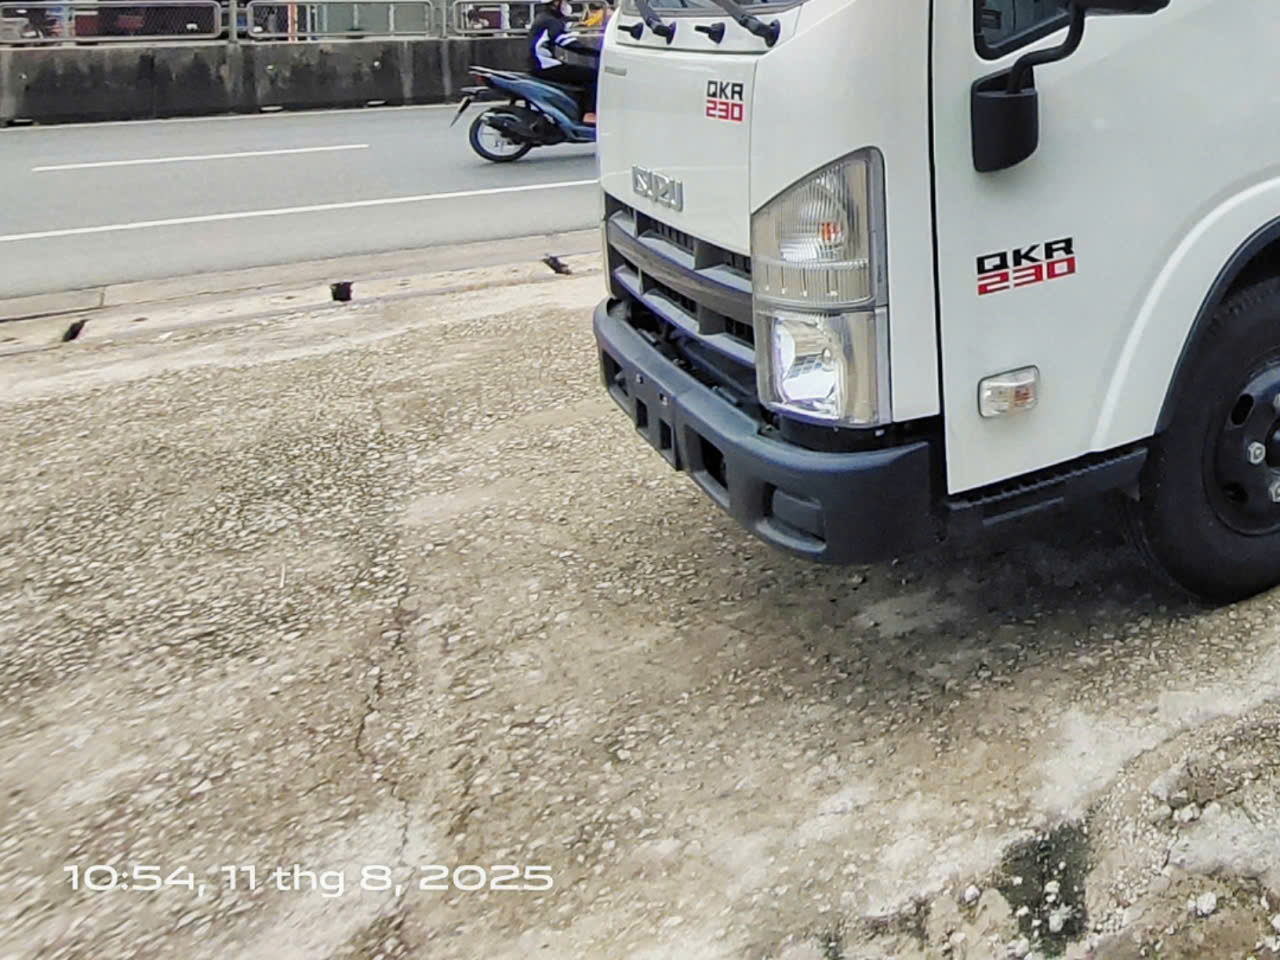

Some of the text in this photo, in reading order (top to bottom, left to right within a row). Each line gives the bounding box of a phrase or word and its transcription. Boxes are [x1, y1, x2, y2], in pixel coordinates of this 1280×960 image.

[706, 80, 744, 101] QKR
[705, 99, 743, 122] 230
[976, 237, 1074, 275] QKR
[977, 256, 1075, 296] 230
